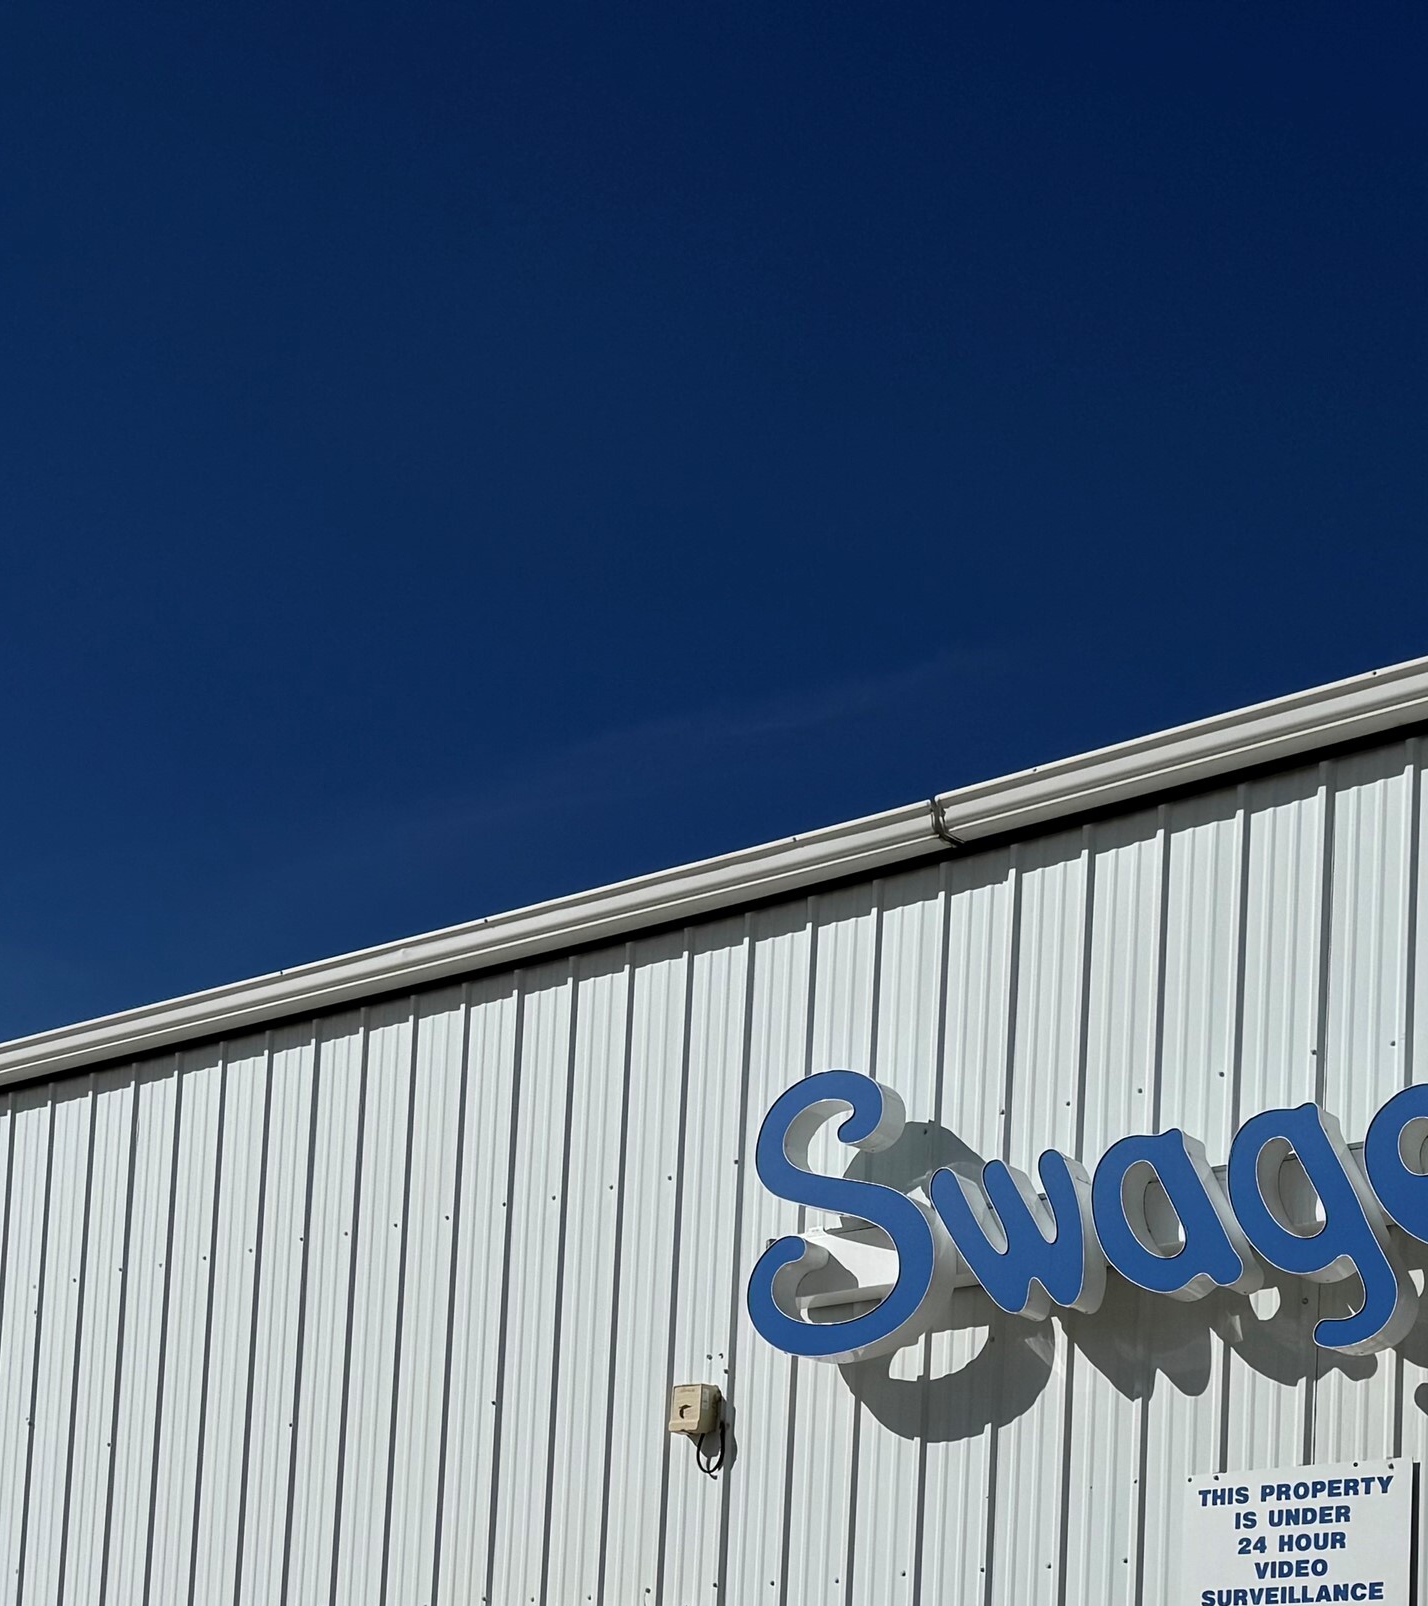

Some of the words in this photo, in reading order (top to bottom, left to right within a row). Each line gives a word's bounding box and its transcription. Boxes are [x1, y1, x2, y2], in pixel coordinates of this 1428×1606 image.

[1198, 1486, 1250, 1507] THIS
[1260, 1475, 1394, 1502] PROPERTY
[1234, 1511, 1257, 1530] IS
[1268, 1505, 1351, 1528] UNDER
[1237, 1536, 1267, 1555] 24
[1278, 1531, 1346, 1552] HOUR
[1254, 1559, 1328, 1580] VIDEO
